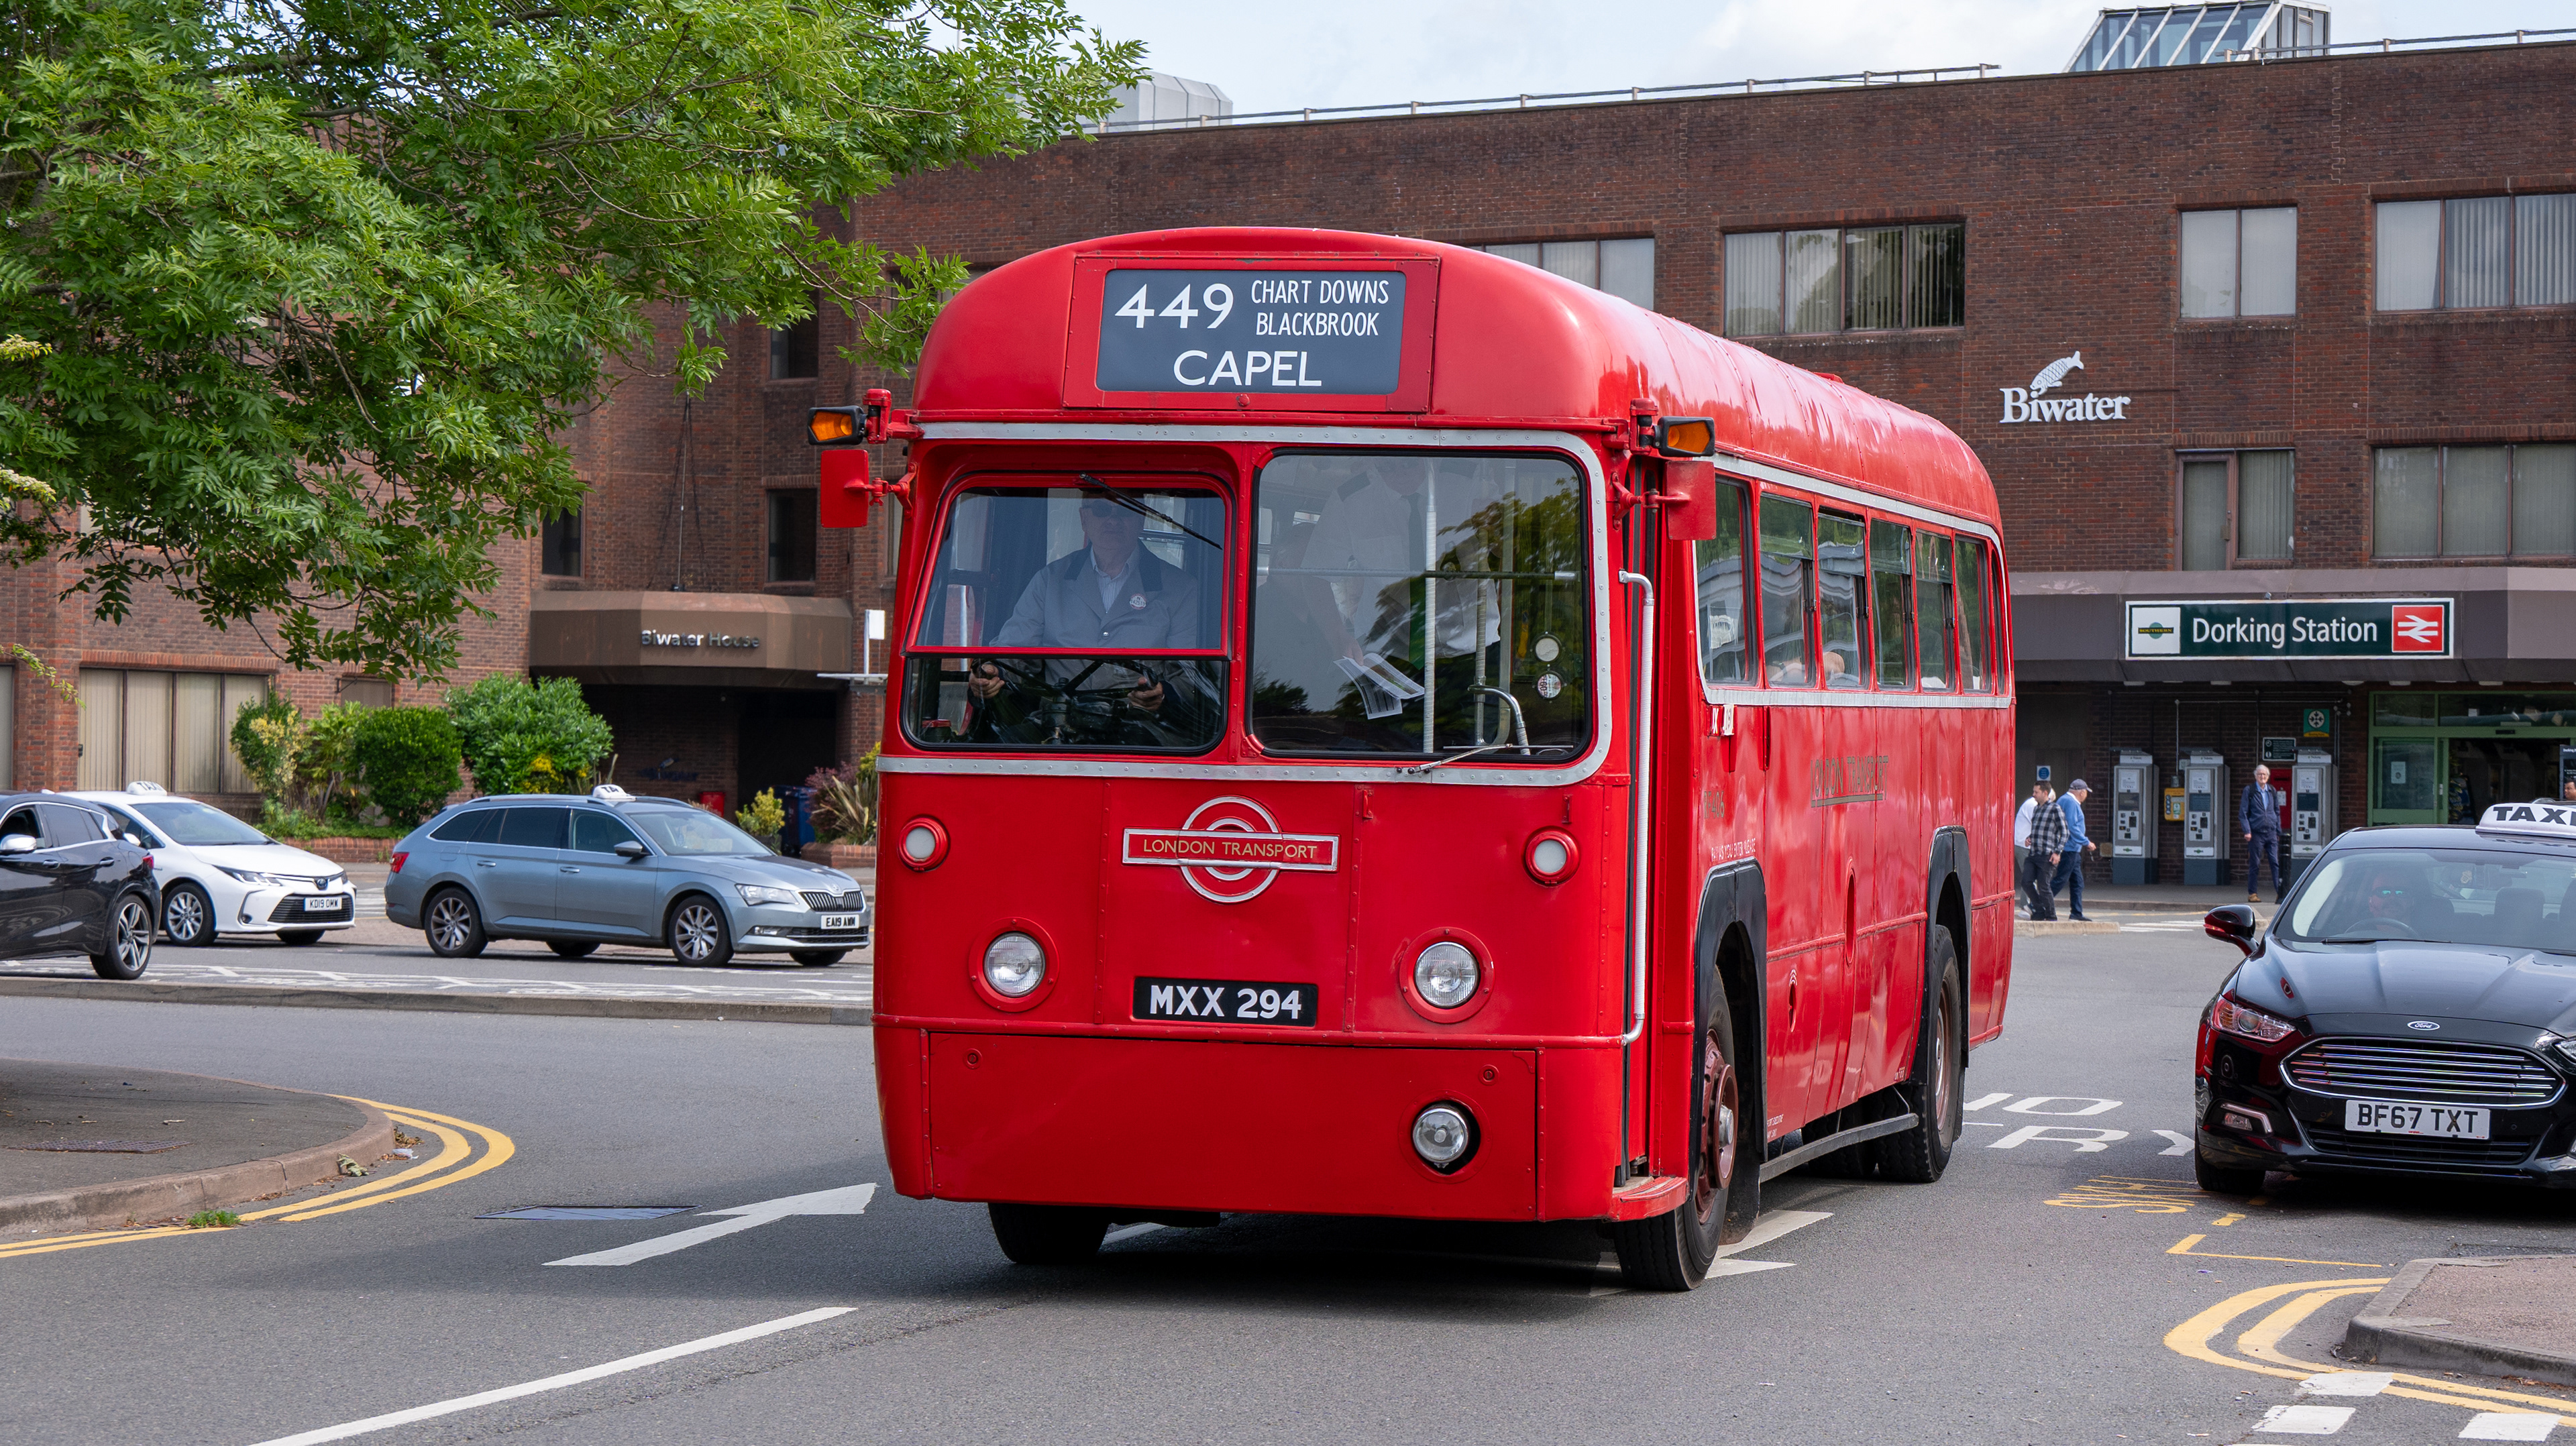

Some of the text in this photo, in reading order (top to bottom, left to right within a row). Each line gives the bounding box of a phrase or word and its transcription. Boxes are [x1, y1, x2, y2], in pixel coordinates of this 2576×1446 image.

[1114, 279, 1389, 329] 449 CHART DOWNS
[1256, 312, 1380, 336] BLACKBROOK
[1173, 349, 1322, 387] CAPEL
[1999, 387, 2131, 423] Biwater
[641, 629, 760, 647] Biwater House
[2192, 617, 2286, 648] Dorking
[2292, 616, 2377, 643] Station
[1811, 756, 1888, 804] LONDON TRANSPORT
[1144, 839, 1317, 858] LONDON TRANSPORT
[826, 917, 842, 927] EA19
[1150, 985, 1301, 1019] MXX 294
[2357, 1103, 2478, 1133] BF67 TXT
